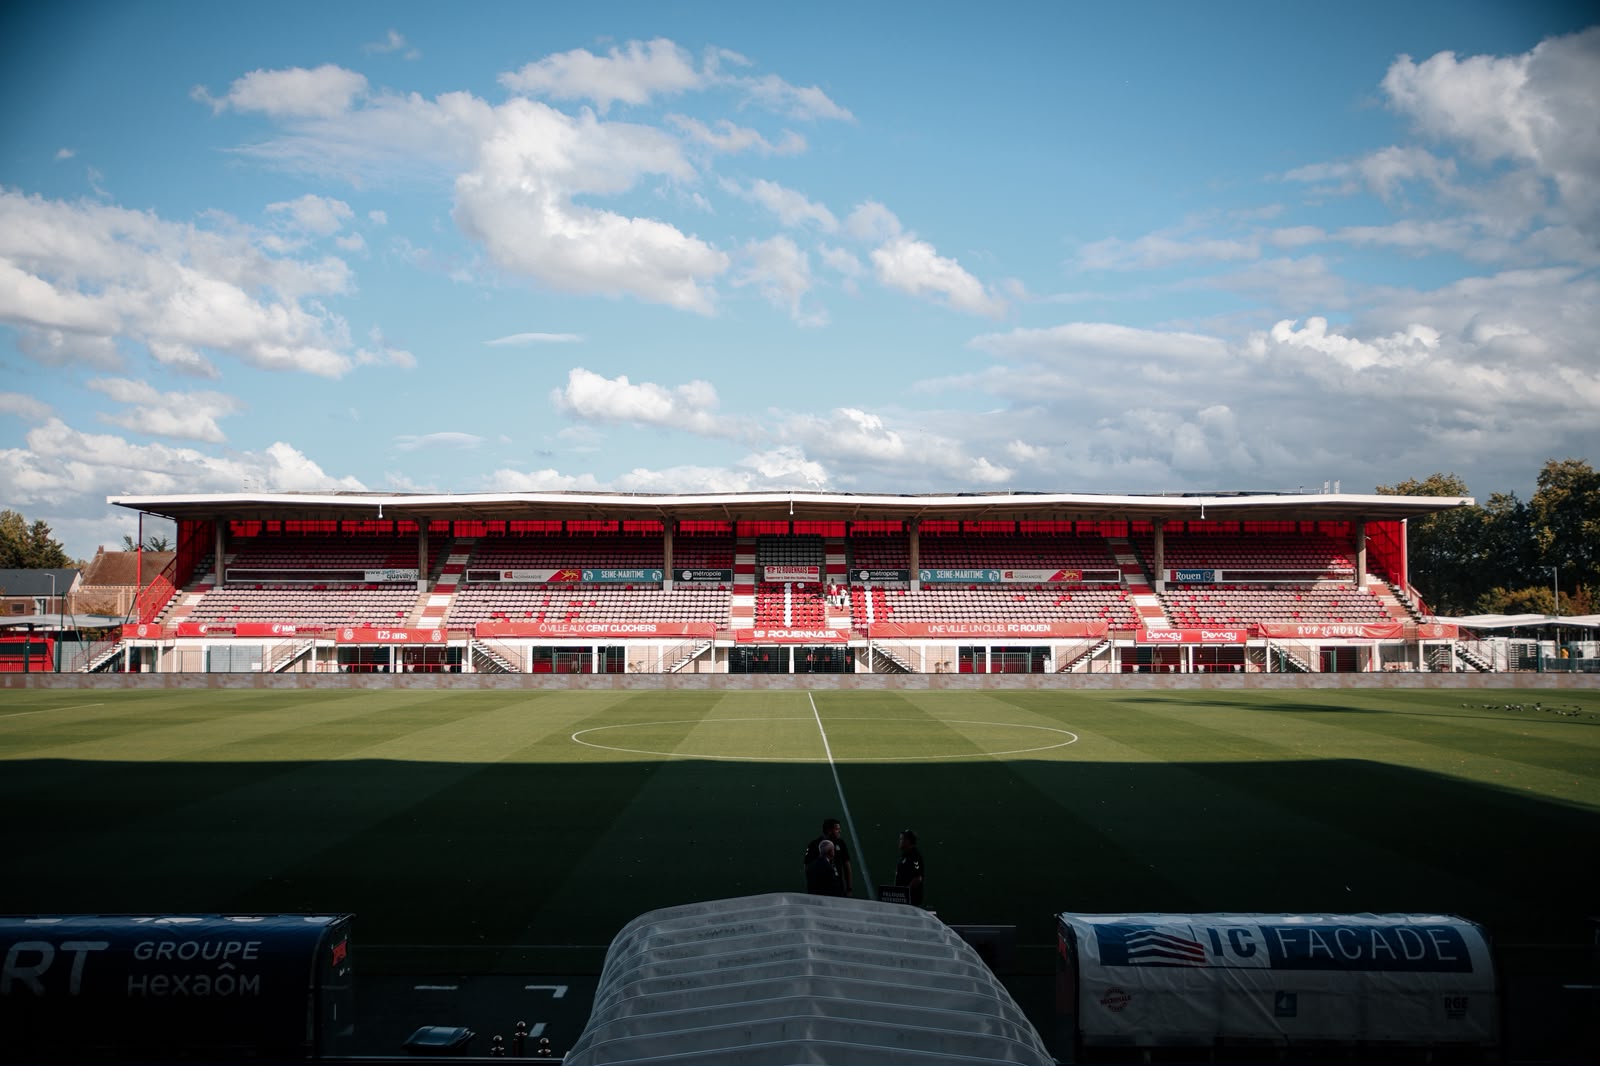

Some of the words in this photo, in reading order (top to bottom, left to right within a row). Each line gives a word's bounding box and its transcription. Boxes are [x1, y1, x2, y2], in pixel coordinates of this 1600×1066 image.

[937, 570, 983, 578] SEINE-MARITIME
[1176, 571, 1201, 580] Rouen
[377, 631, 390, 639] 125
[1207, 928, 1256, 958] IC
[1274, 927, 1457, 961] FACADE
[133, 940, 262, 960] GROUPE
[1445, 997, 1468, 1008] RGE
